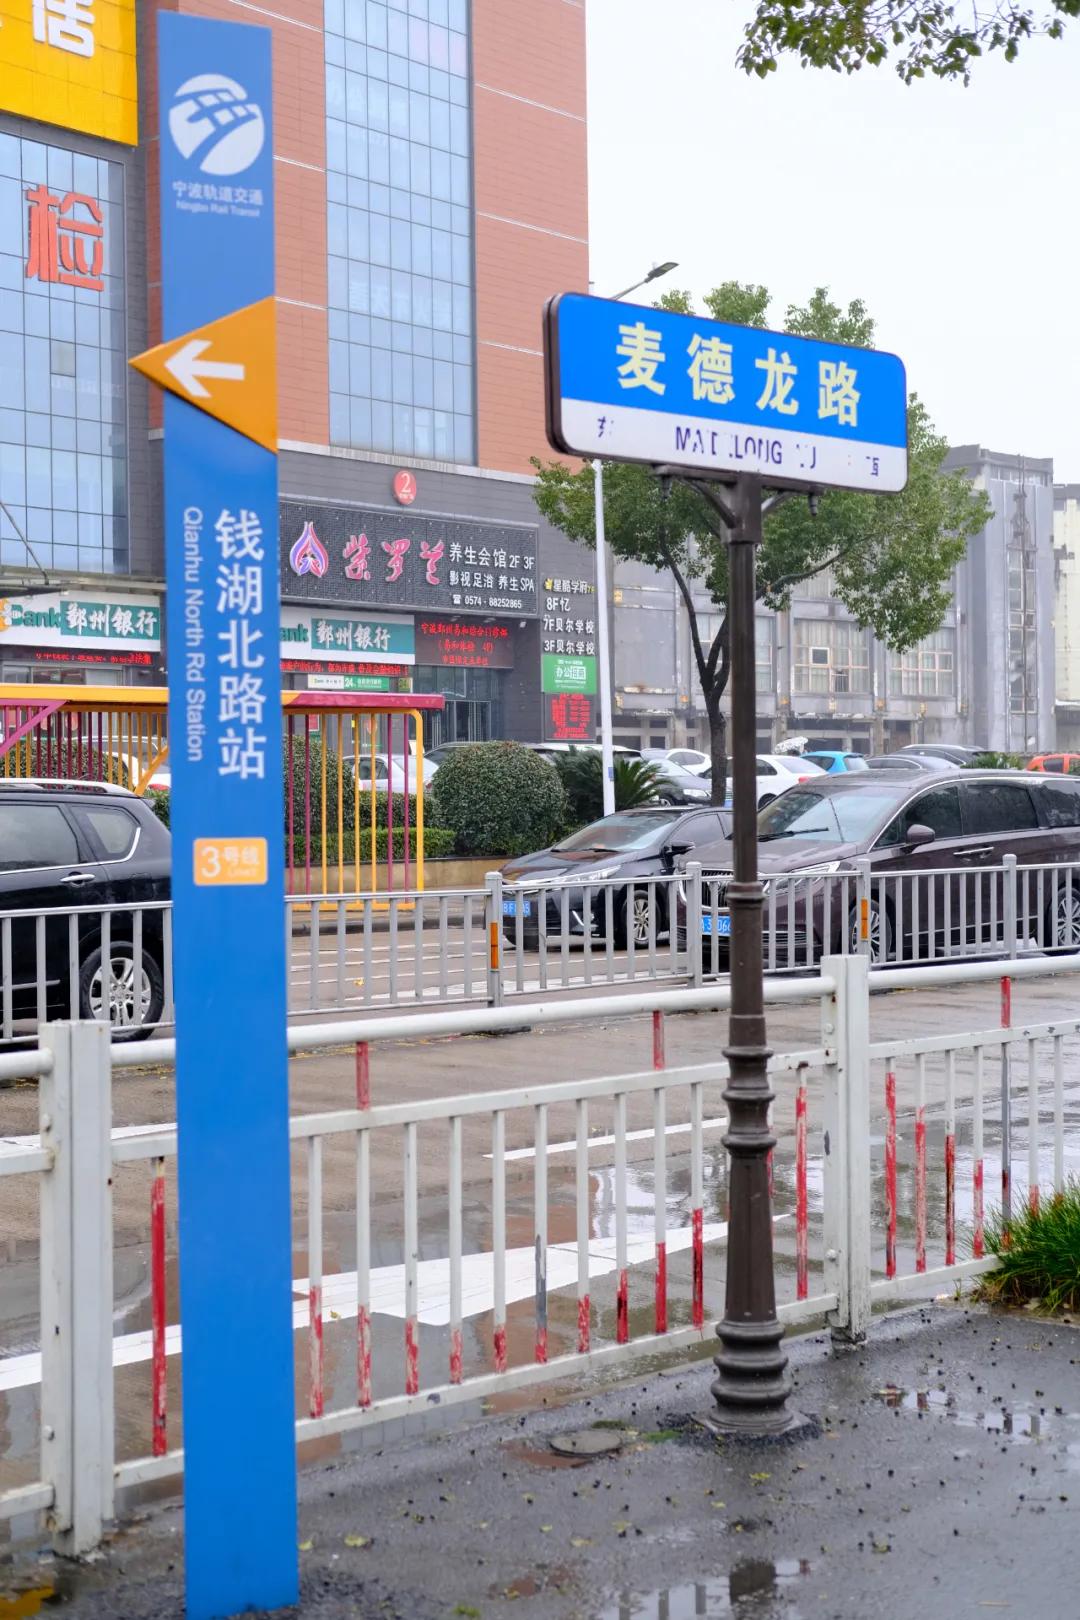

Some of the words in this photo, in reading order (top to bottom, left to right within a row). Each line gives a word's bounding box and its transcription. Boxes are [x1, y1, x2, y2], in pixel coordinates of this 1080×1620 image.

[172, 180, 263, 206] 宁波轨道交通
[26, 184, 104, 291] 检
[615, 321, 862, 427] 麦德龙路
[184, 506, 204, 582] Qianhu
[449, 542, 507, 568] 养生会馆
[523, 556, 535, 570] 3F
[449, 570, 494, 589] 影视足浴
[185, 589, 205, 647] North
[214, 508, 267, 779] 钱湖北路站
[186, 652, 206, 682] Rd
[186, 689, 207, 762] Station
